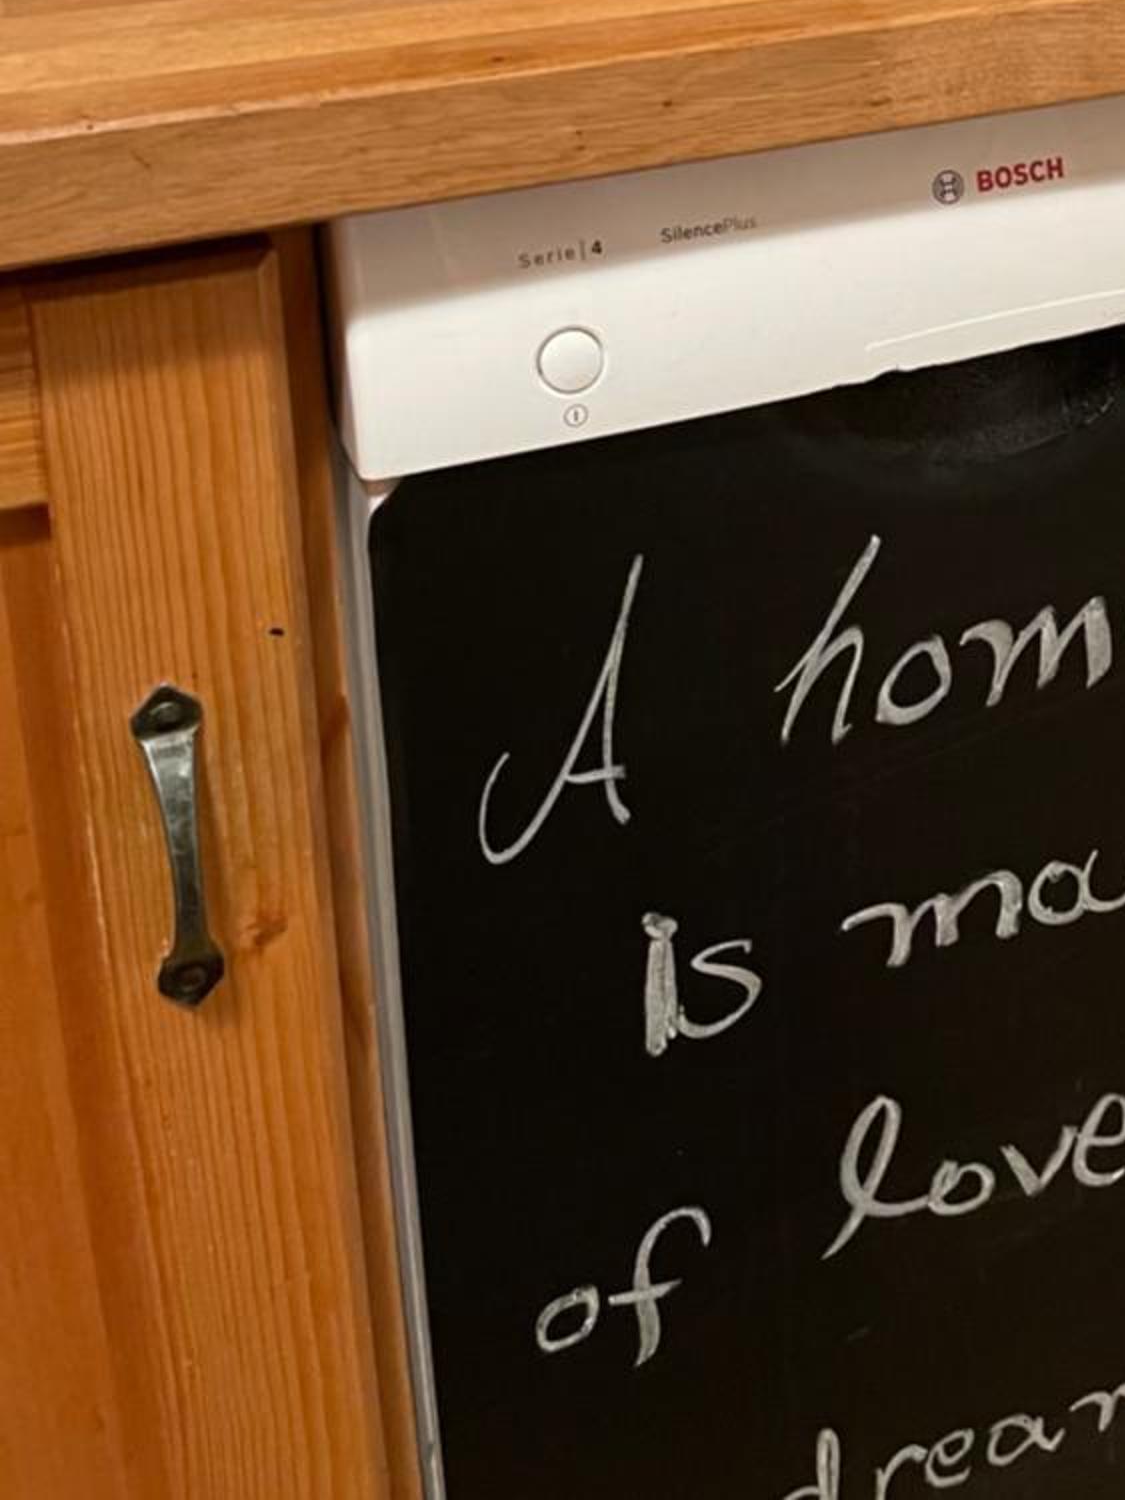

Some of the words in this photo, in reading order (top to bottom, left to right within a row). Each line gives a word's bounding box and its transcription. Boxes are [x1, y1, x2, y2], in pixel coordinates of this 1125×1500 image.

[976, 156, 1065, 193] BOSCH
[478, 554, 644, 864] A
[535, 1206, 711, 1367] of
